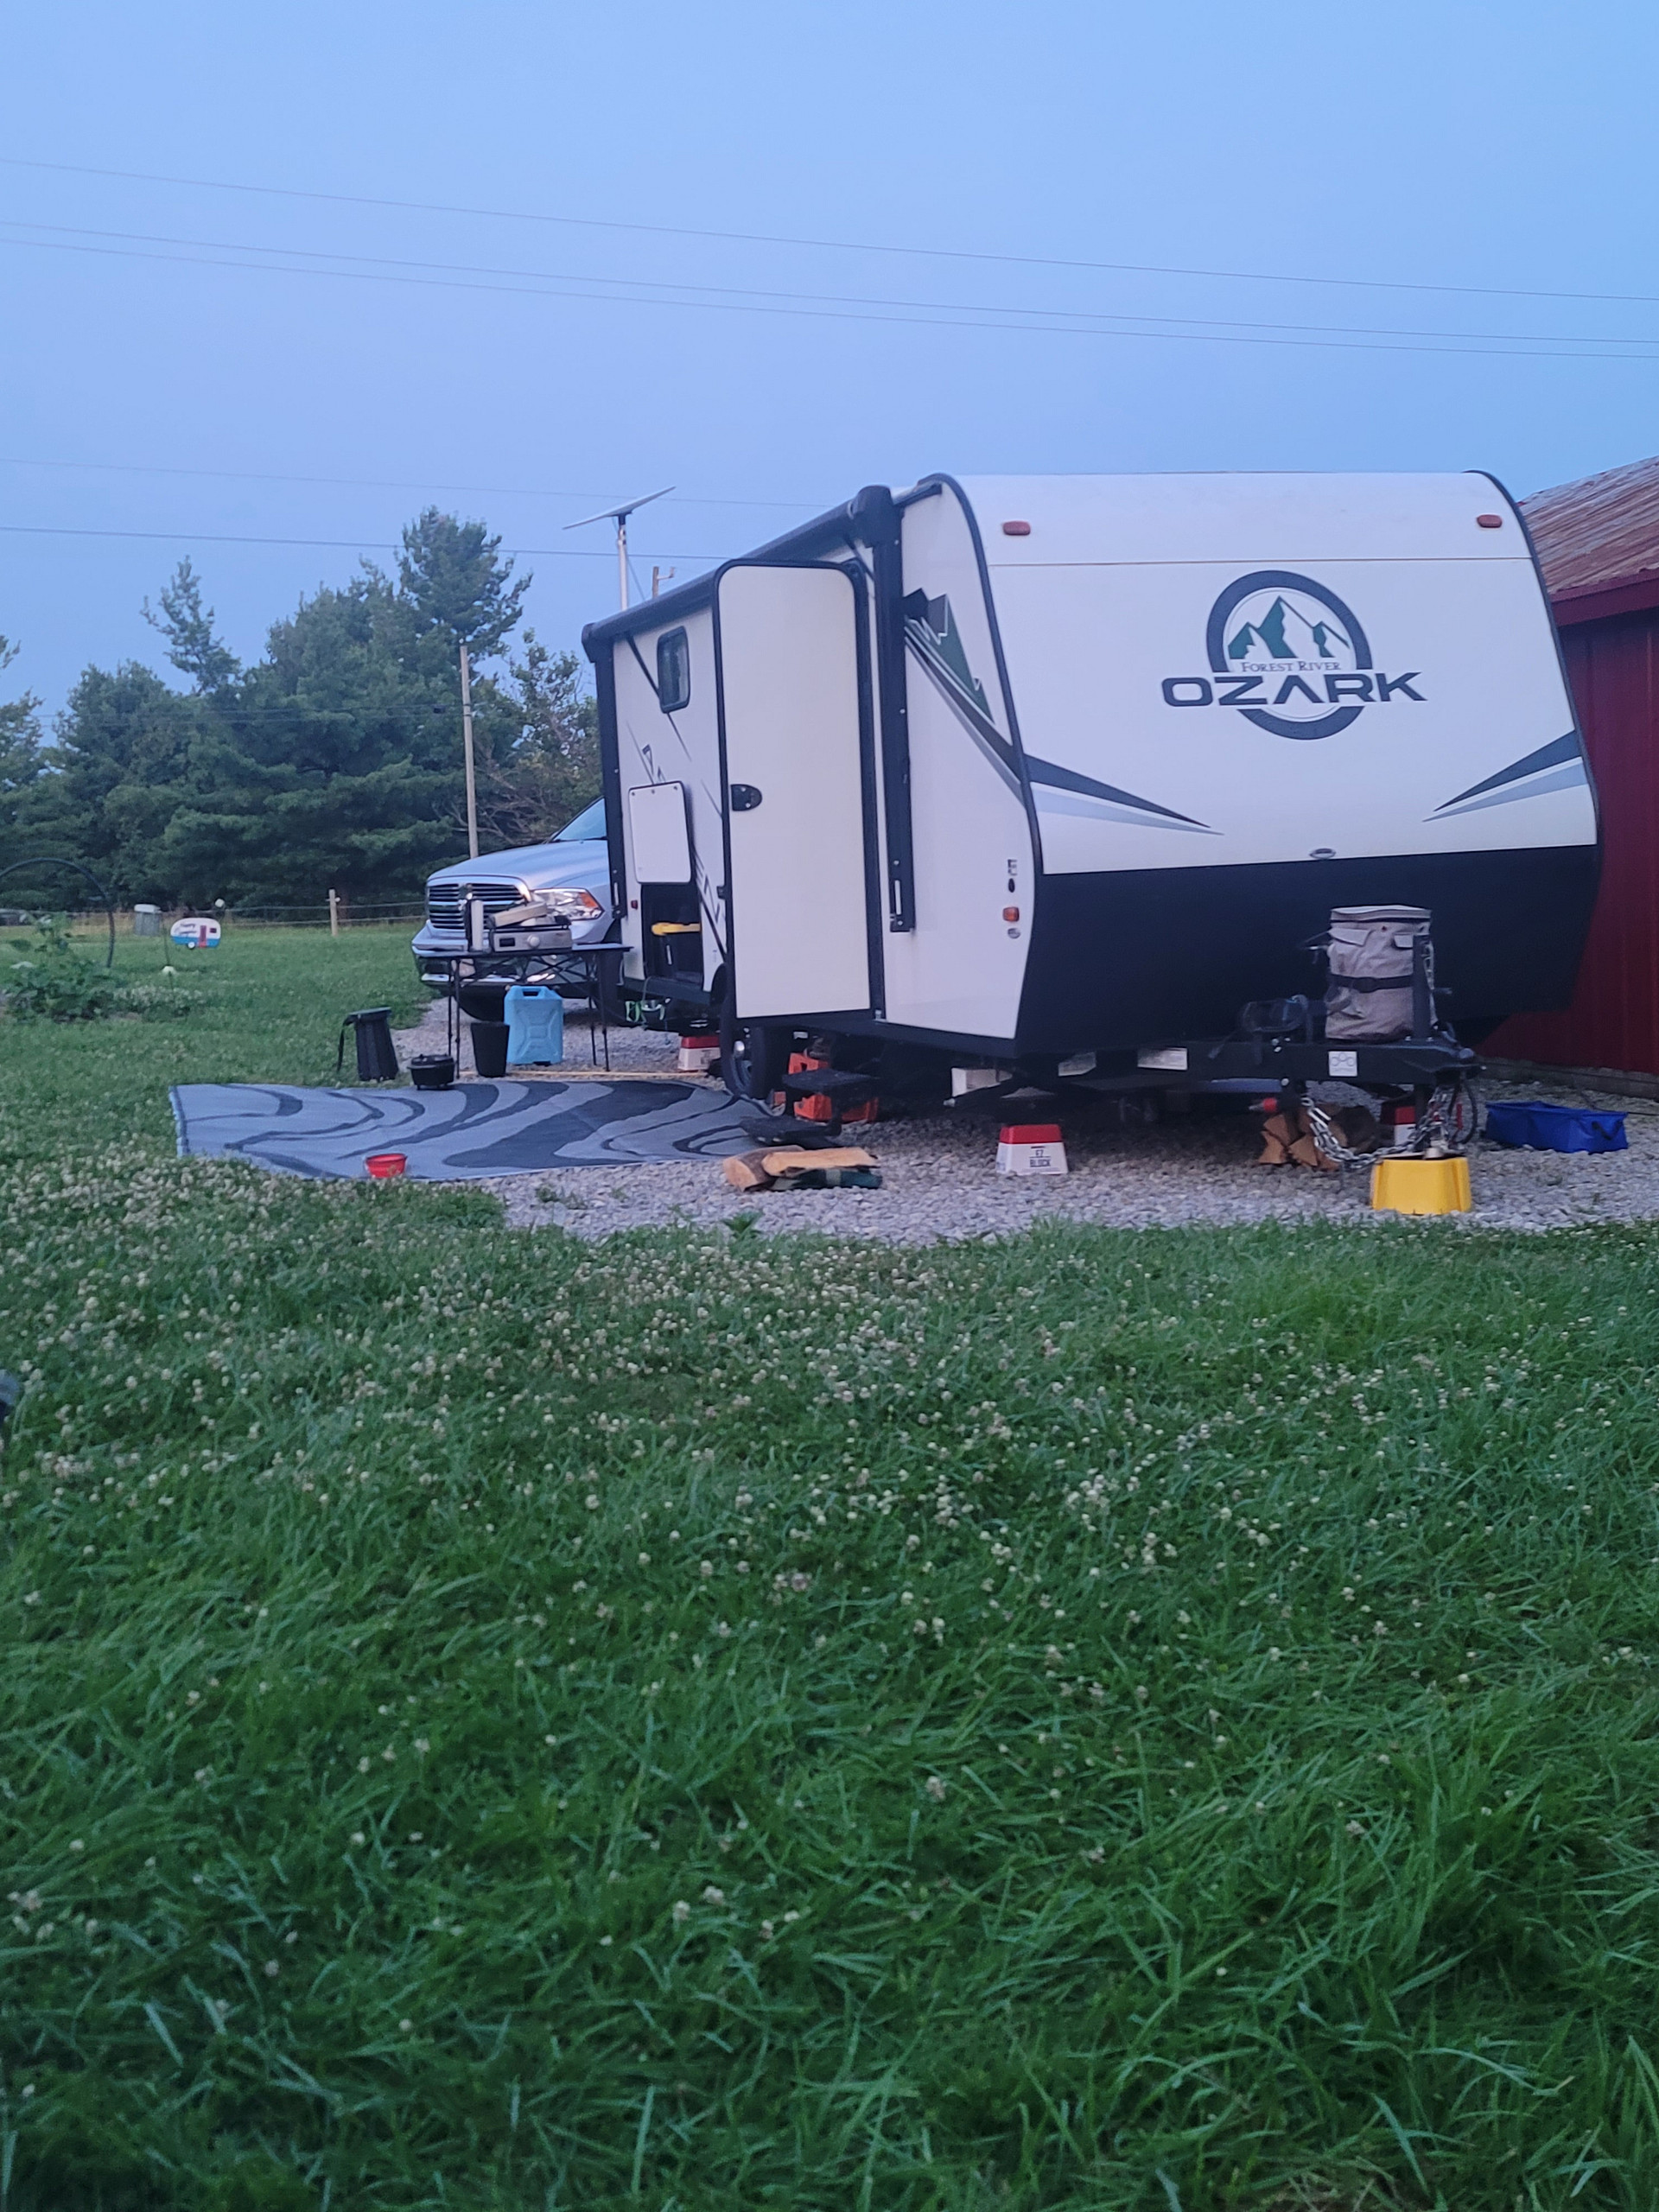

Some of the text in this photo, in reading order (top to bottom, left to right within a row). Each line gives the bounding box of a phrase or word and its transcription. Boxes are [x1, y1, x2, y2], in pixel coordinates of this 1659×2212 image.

[1241, 660, 1341, 672] FOREST RIVER
[1161, 672, 1428, 707] OZARK
